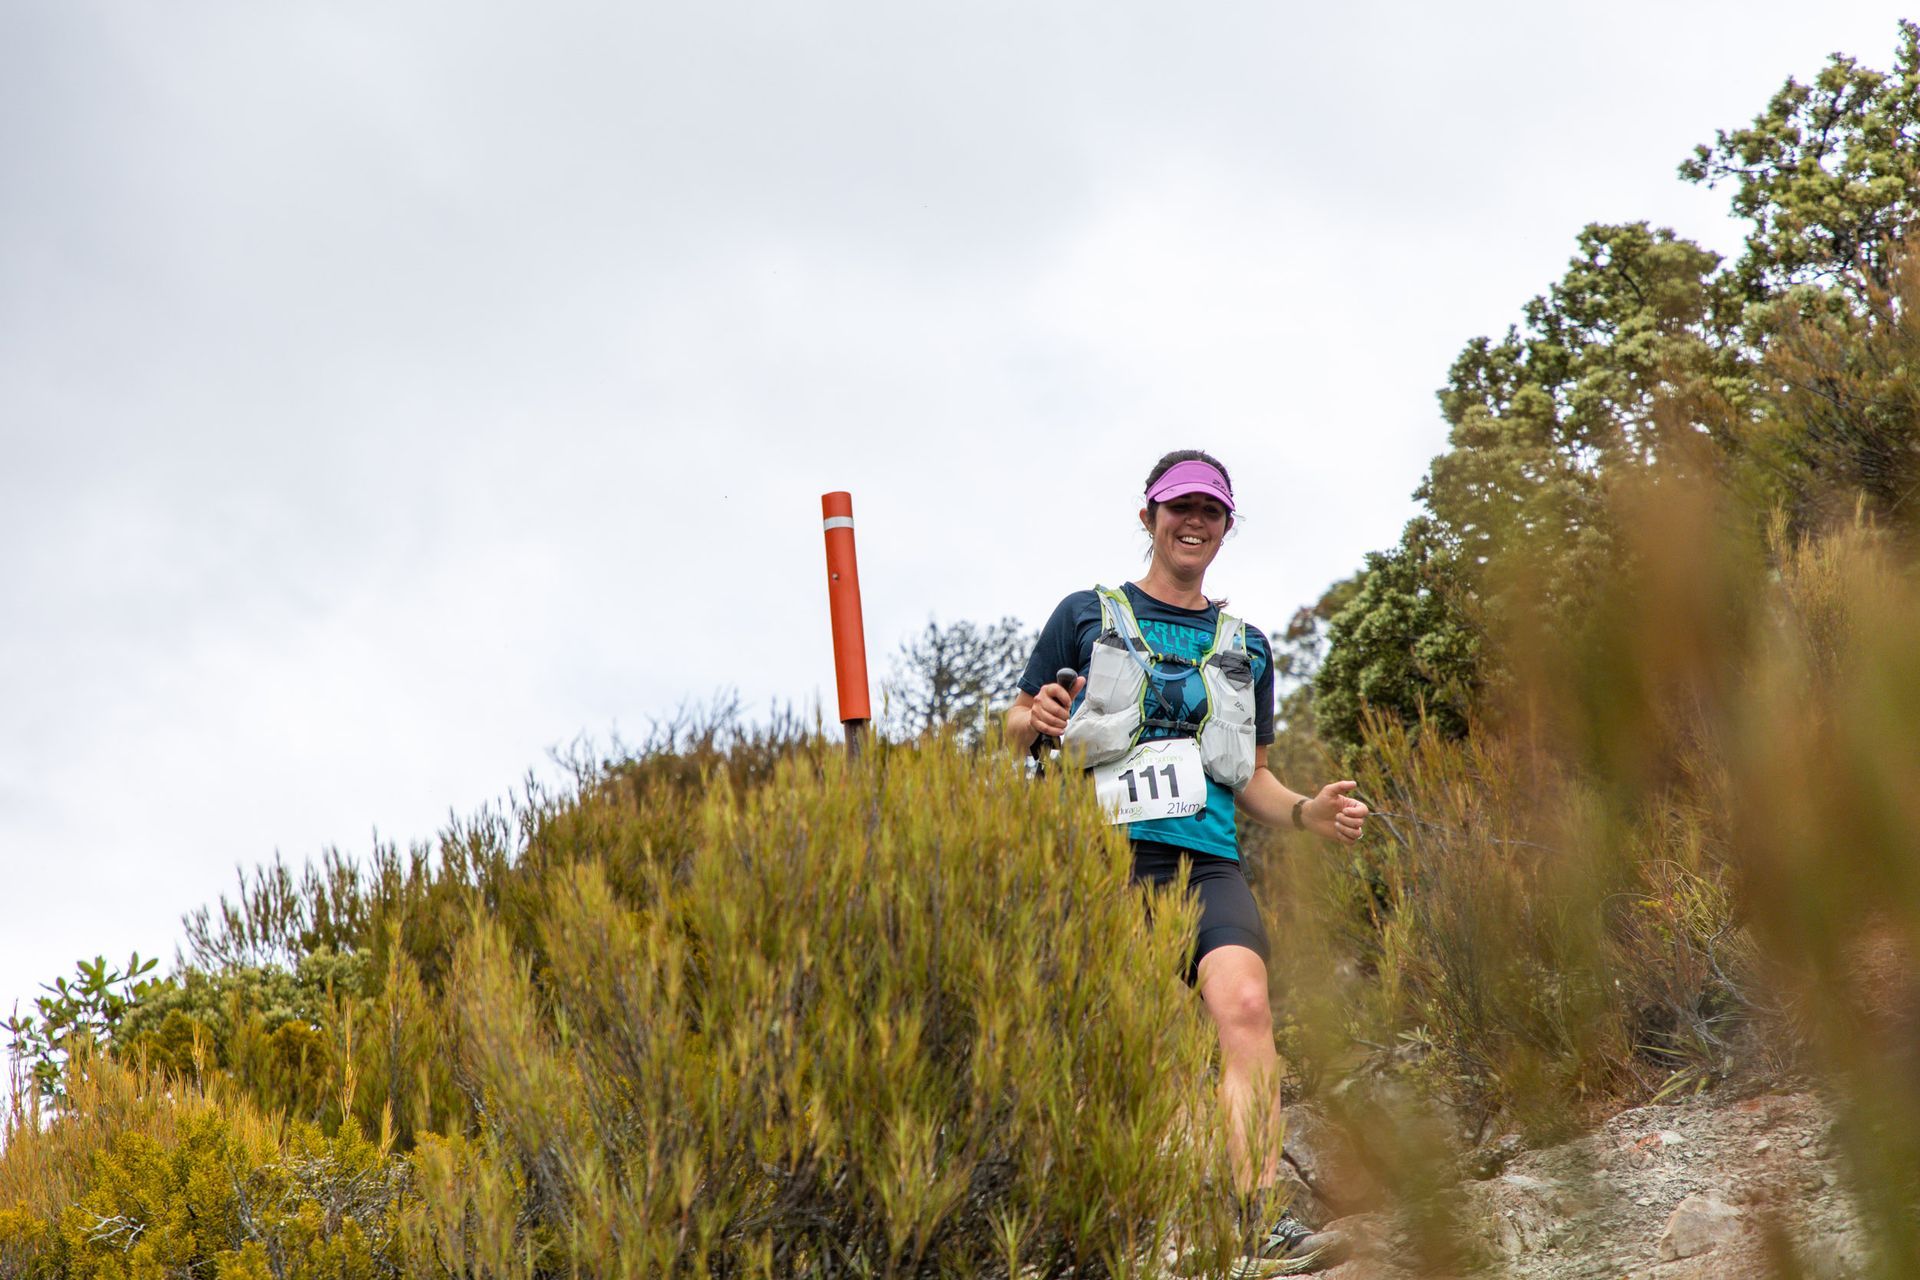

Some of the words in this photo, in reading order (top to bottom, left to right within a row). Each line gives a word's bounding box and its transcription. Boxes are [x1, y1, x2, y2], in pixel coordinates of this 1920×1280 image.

[1139, 619, 1211, 641] PRIN
[1145, 630, 1200, 653] ALLE
[1118, 763, 1180, 803] 111
[1167, 802, 1200, 814] 21km
